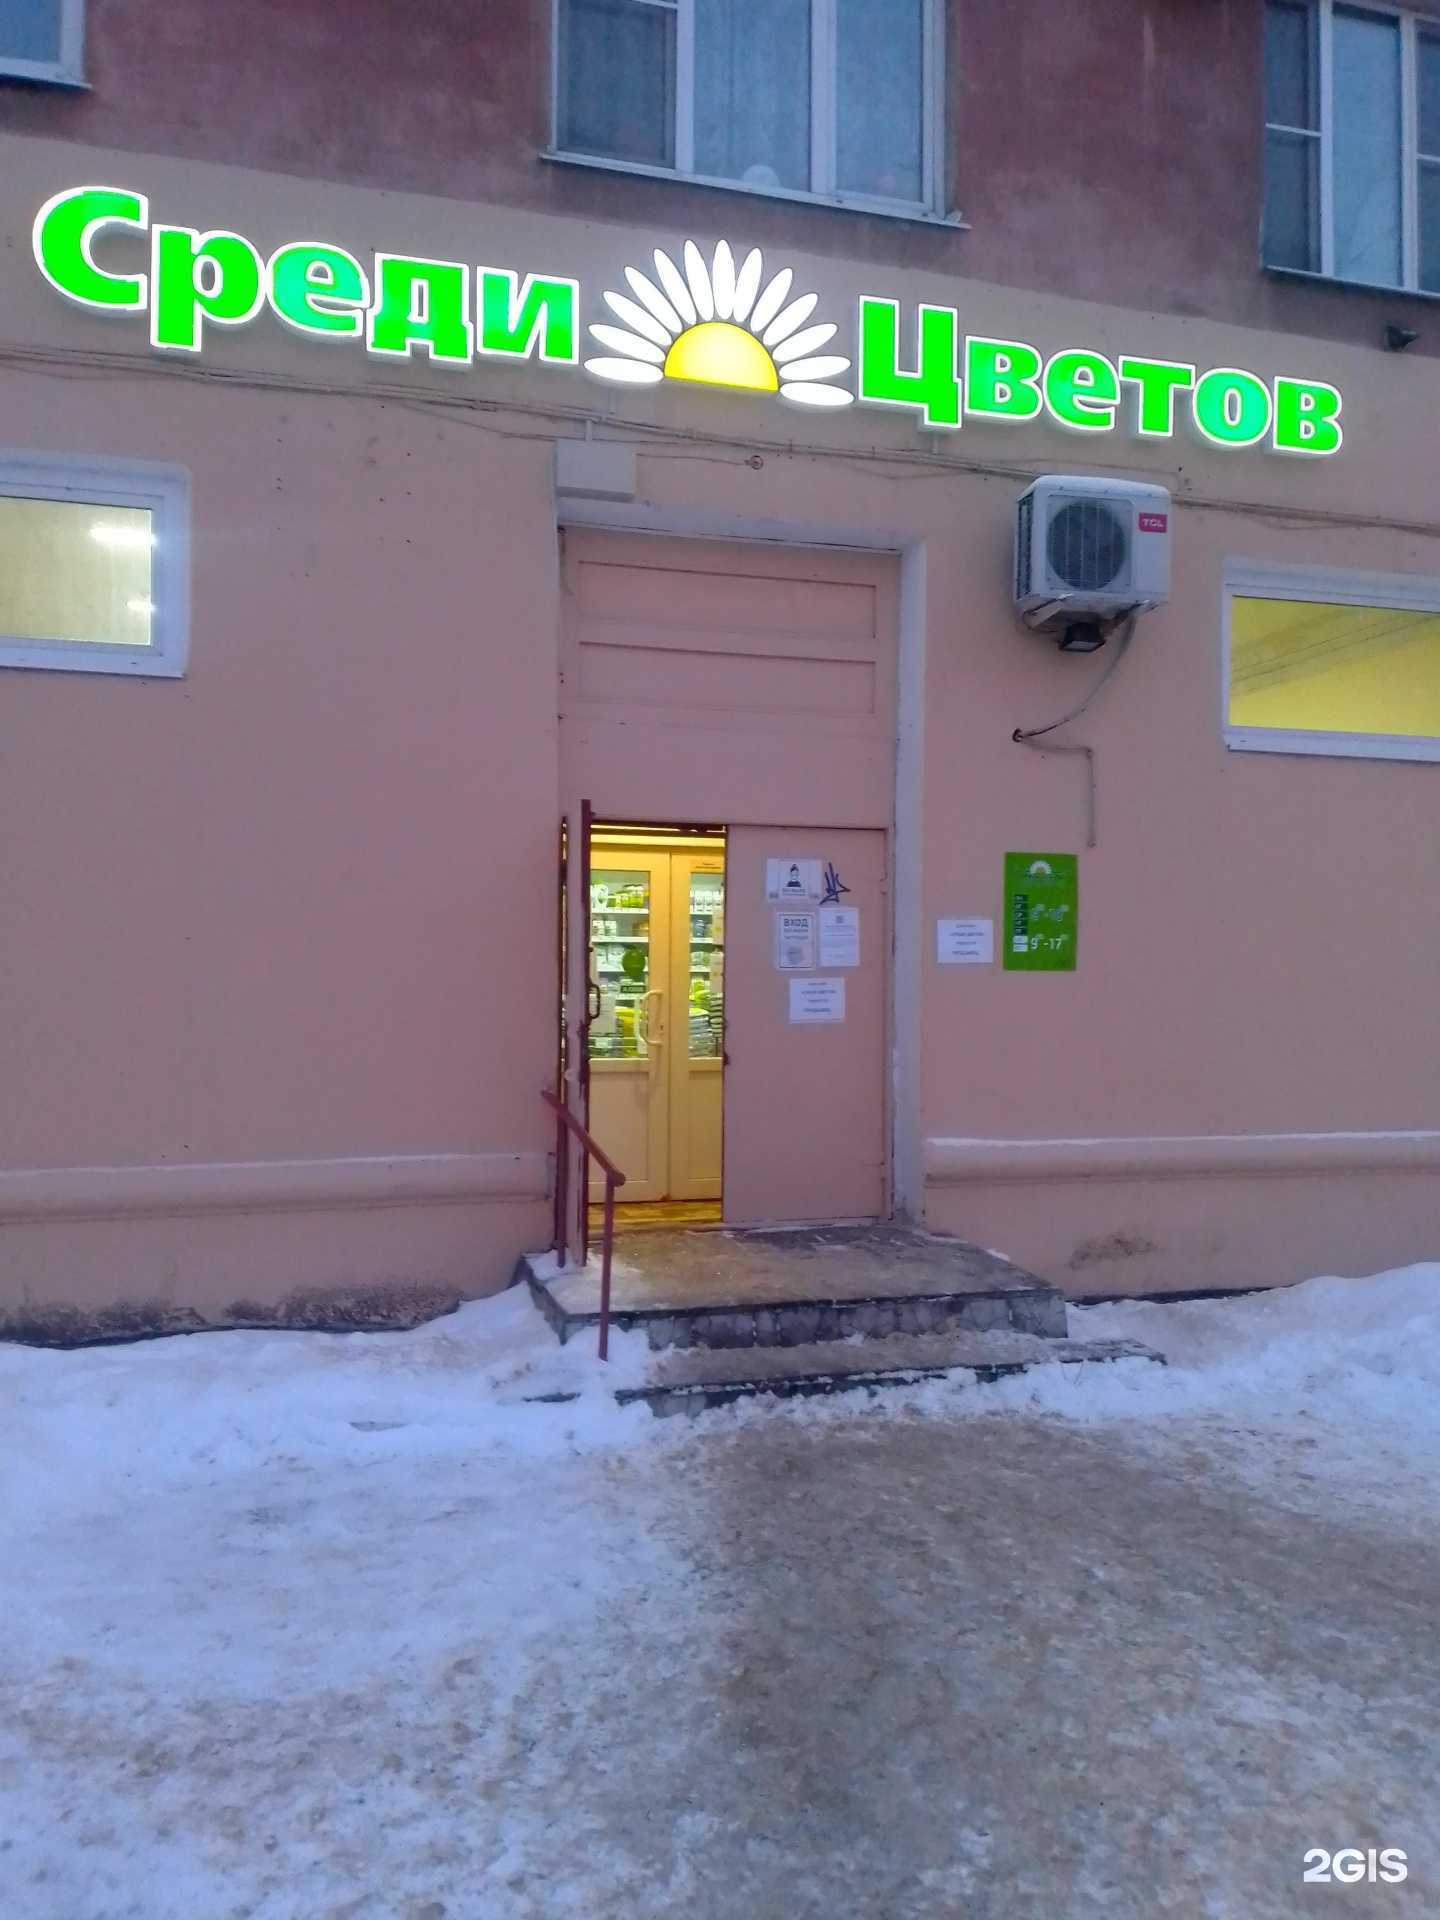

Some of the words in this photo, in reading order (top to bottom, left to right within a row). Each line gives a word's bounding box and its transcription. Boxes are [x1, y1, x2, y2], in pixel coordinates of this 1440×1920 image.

[33, 186, 580, 363] Среди
[858, 295, 1344, 456] Цветов
[1142, 518, 1164, 528] TCL
